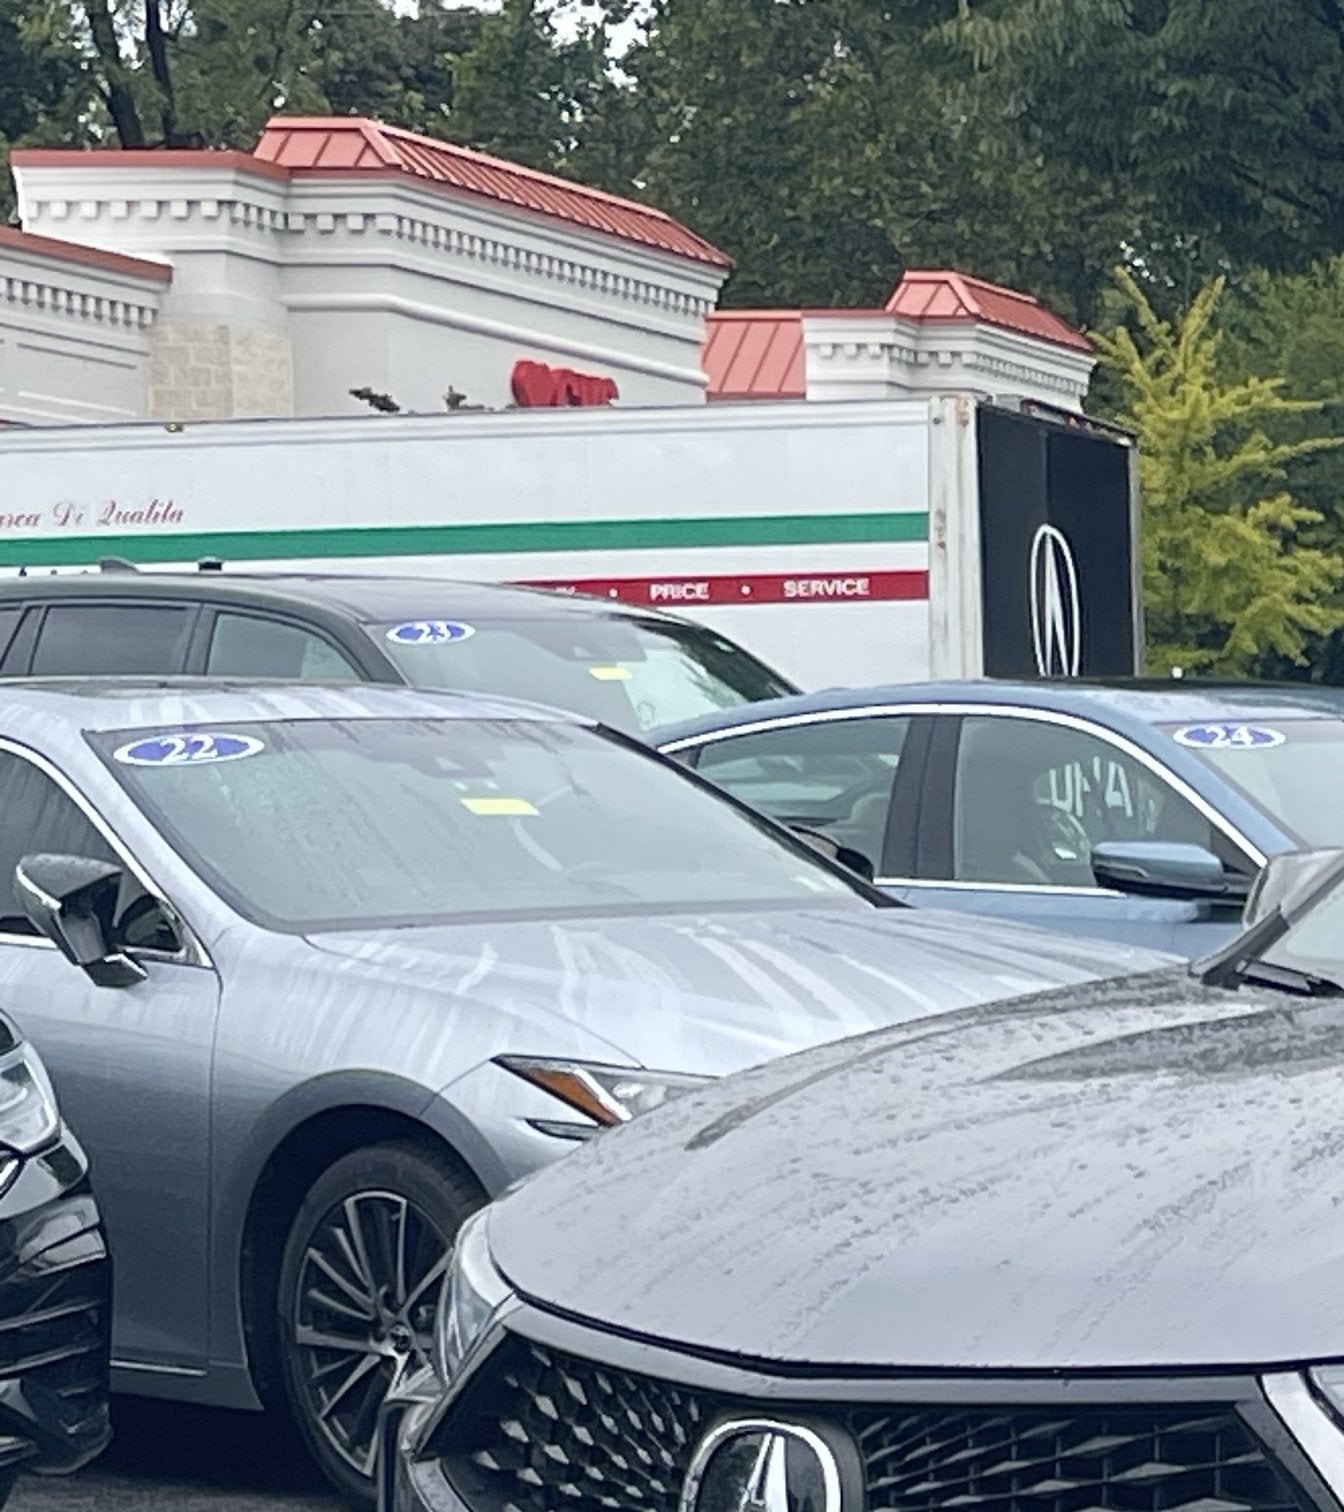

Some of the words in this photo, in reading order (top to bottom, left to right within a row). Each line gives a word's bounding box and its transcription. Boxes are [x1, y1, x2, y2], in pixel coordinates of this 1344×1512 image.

[650, 582, 710, 601] PRICE
[783, 578, 870, 598] SERVICE
[1205, 725, 1254, 748] 24
[159, 734, 218, 763] 22
